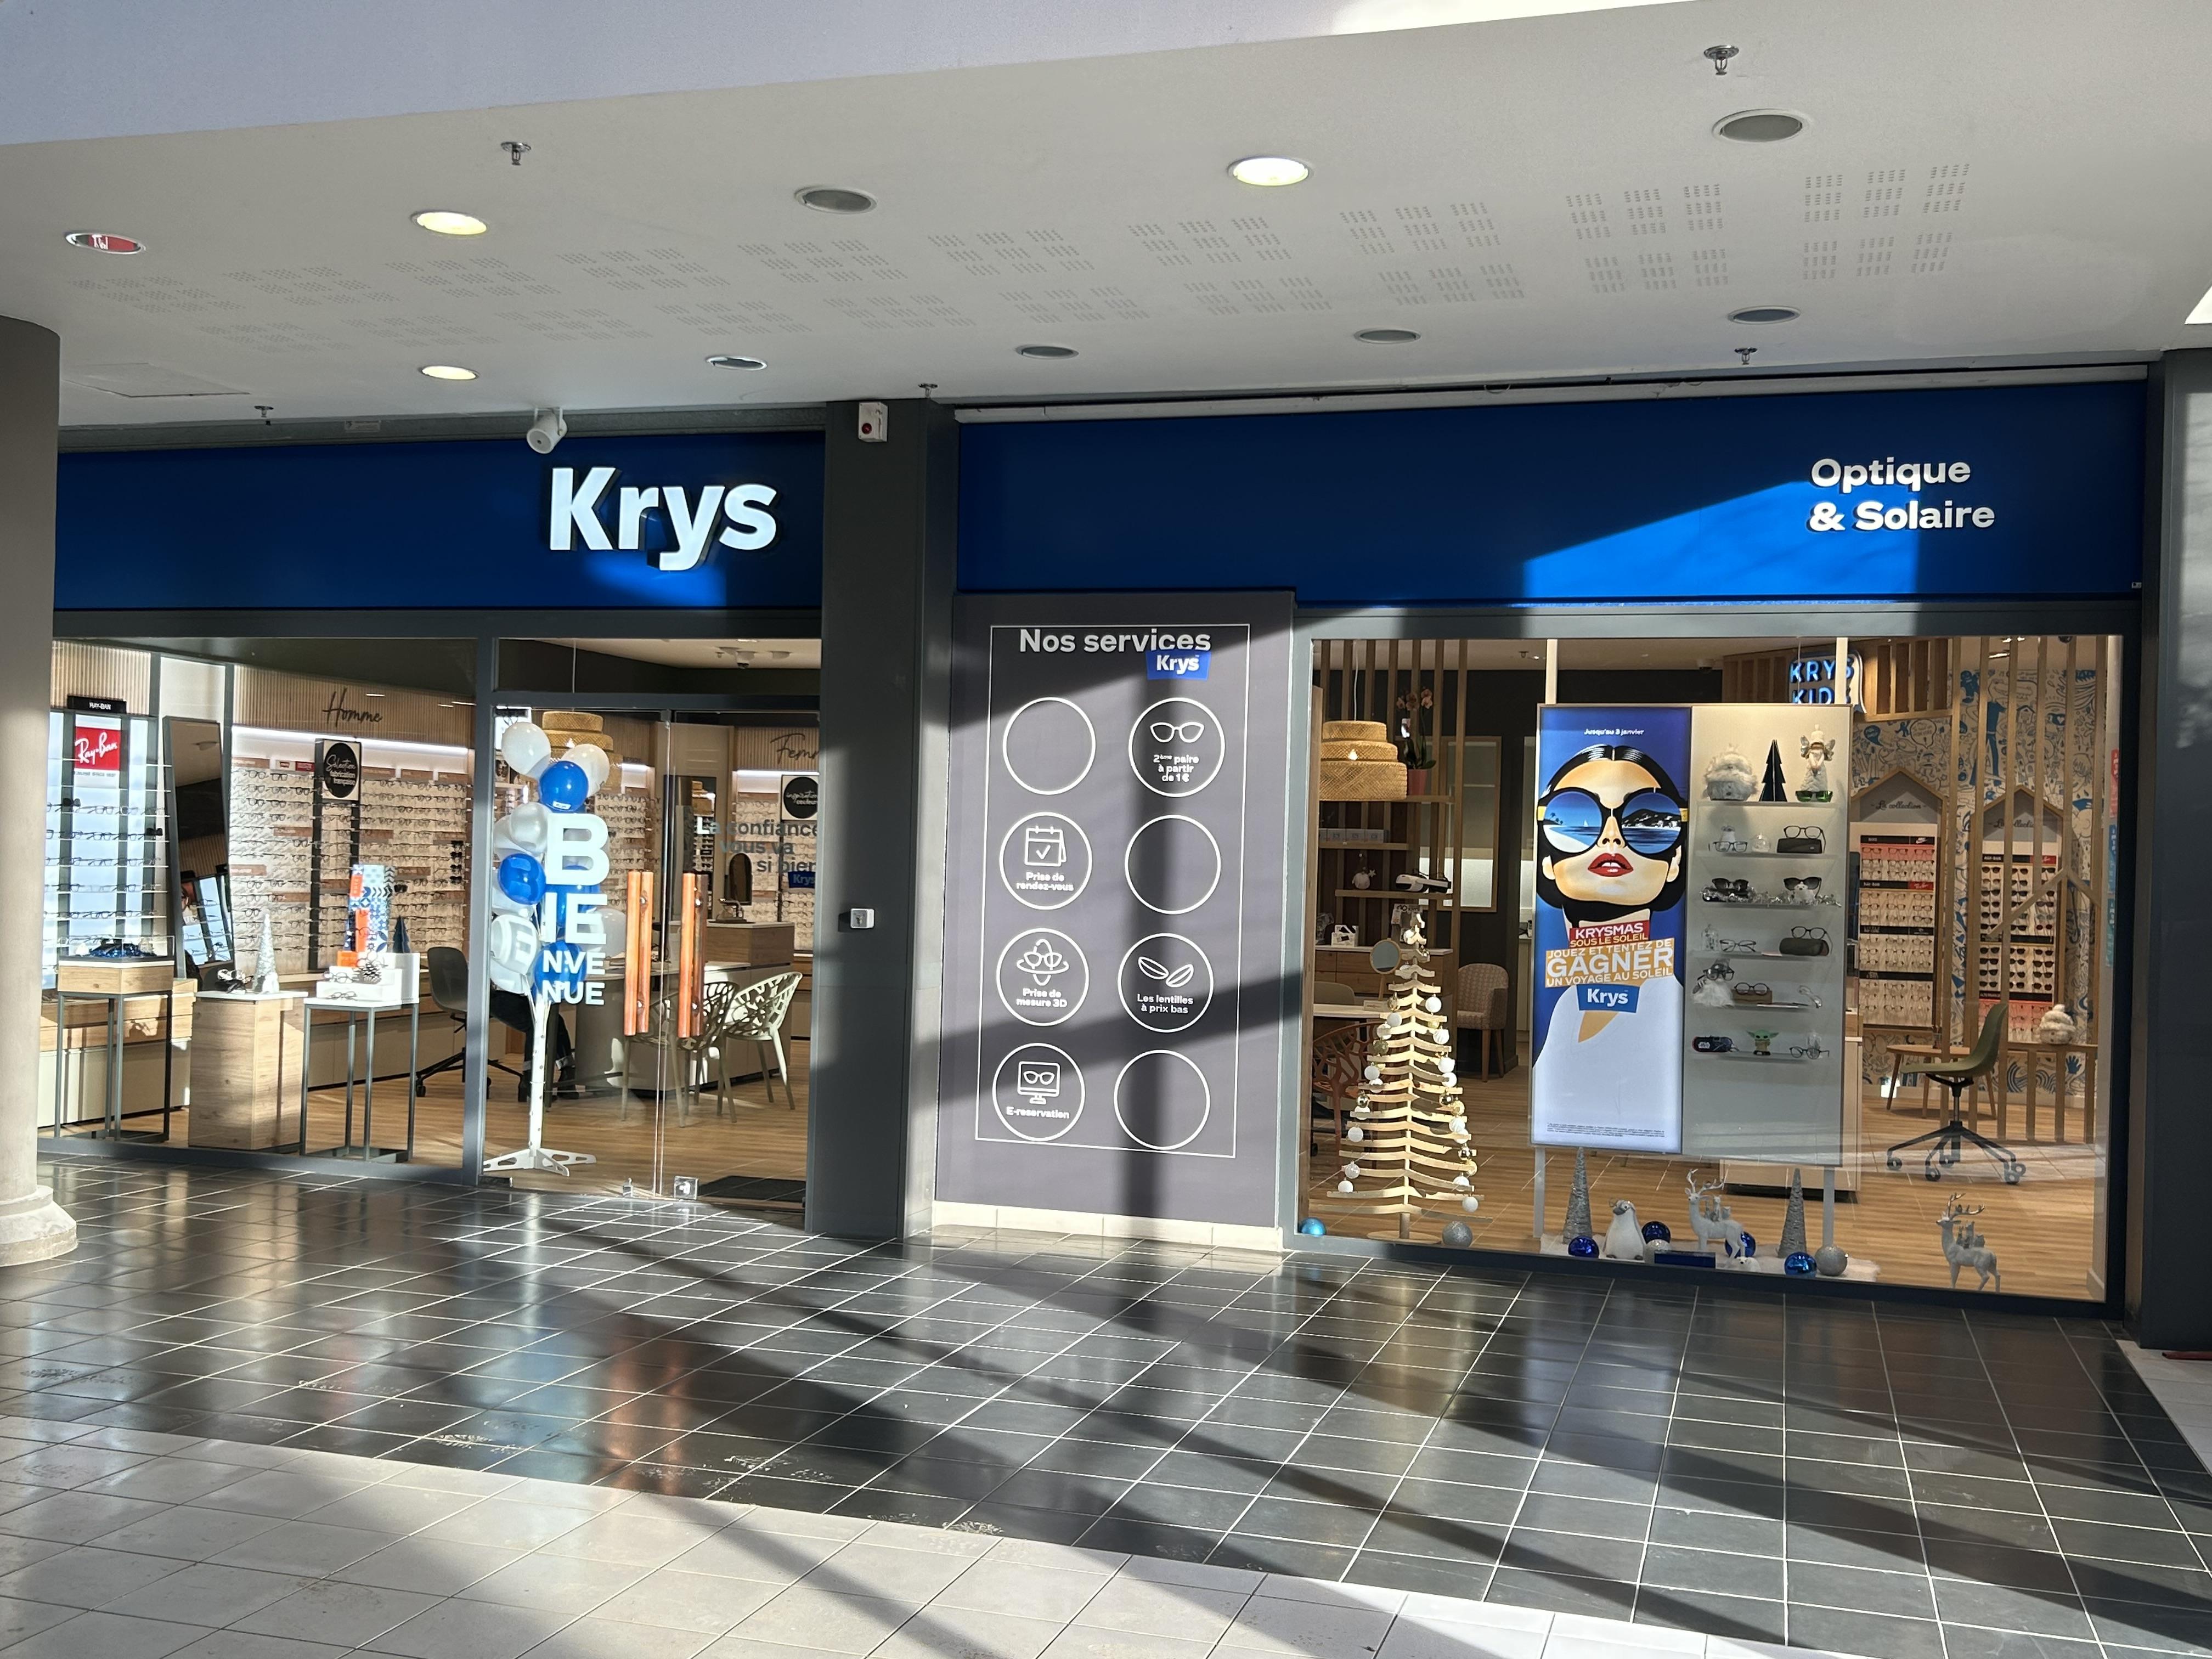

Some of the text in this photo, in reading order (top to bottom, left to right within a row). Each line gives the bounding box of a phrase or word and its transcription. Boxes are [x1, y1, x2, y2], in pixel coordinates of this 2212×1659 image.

[1811, 456, 1971, 493] Optique
[550, 466, 777, 571] Krys
[1809, 500, 1995, 532] & Solaire
[1019, 628, 1211, 653] Nos services
[1156, 654, 1200, 675] Krys
[1792, 687, 1850, 704] KID
[323, 687, 383, 727] Homme
[75, 731, 118, 765] Ray-Ban
[770, 733, 820, 765] Fem
[1174, 754, 1199, 765] paire
[1158, 764, 1194, 775] à partir
[1161, 774, 1174, 782] de
[697, 817, 720, 835] La
[545, 813, 610, 886] B
[720, 840, 795, 855] vous va
[756, 856, 772, 872] si
[1016, 881, 1074, 891] rendez-vous
[1025, 872, 1065, 882] Prise de
[544, 892, 608, 945] IE
[1570, 932, 1649, 947] SOUS LE SOLEIL
[1576, 922, 1644, 939] KRYSMAS
[1548, 939, 1672, 959] JOUEZ ET TENTEZ DE
[542, 950, 606, 975] NVE
[1547, 947, 1673, 978] GAGNER
[1546, 967, 1673, 987] UN VOYAGE AU SOLEIL
[541, 980, 605, 1005] NUE
[1023, 988, 1062, 998] Prise de
[1137, 994, 1194, 1005] Les lentilles
[1587, 988, 1628, 1007] Krys
[1016, 998, 1068, 1007] mesure 3D
[1141, 1003, 1189, 1014] à prix bas
